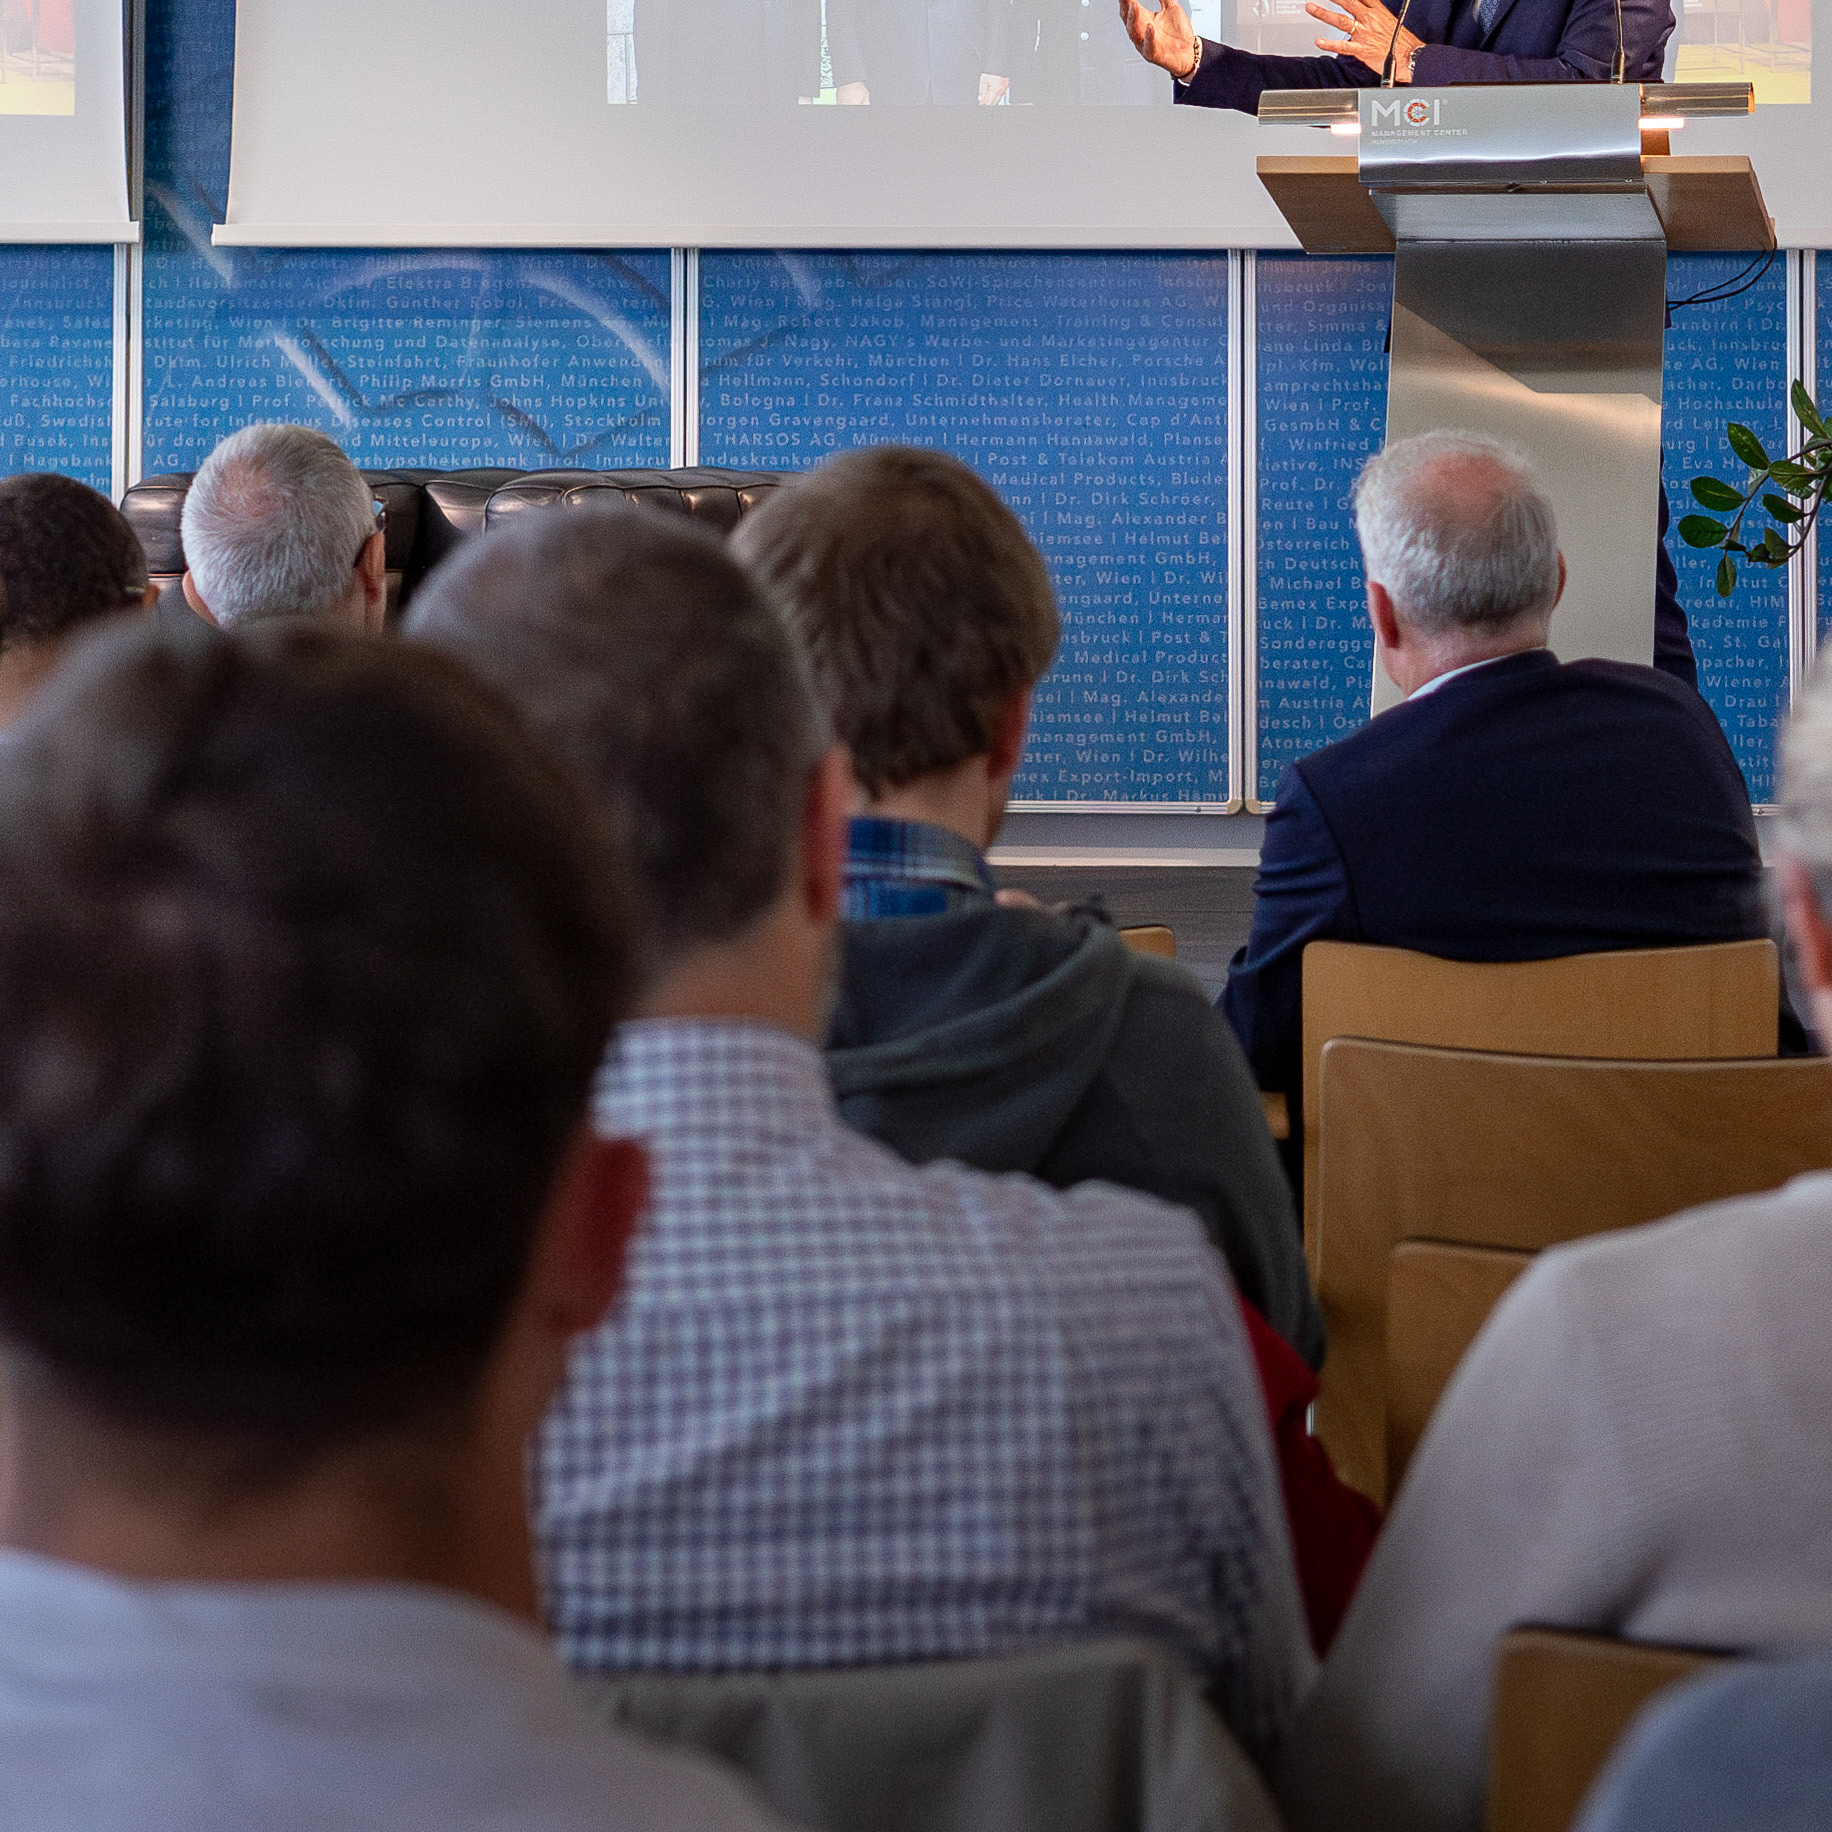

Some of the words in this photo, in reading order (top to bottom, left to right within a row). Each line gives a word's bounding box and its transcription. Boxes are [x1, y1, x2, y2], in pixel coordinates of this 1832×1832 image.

[1371, 98, 1440, 127] MCI
[1371, 129, 1432, 137] MANAGEMENT
[999, 335, 1032, 348] und
[868, 354, 950, 367] München
[1006, 354, 1050, 367] Hans
[820, 374, 914, 387] Schondorf
[971, 374, 1030, 387] Dieter
[720, 394, 796, 410] Bologna
[853, 394, 903, 407] Franz
[1058, 394, 1119, 407] Health
[1126, 414, 1161, 429] Cap
[715, 434, 801, 446] THARSOS
[852, 434, 935, 446] München
[955, 434, 1038, 446] Hermann
[987, 452, 1027, 465] Post
[1037, 452, 1048, 465] &
[1060, 452, 1135, 465] Telekom
[1144, 452, 1210, 465] Austria
[991, 474, 1065, 486] Medical
[1091, 492, 1128, 505] Dirk
[1111, 512, 1206, 525] Alexander
[1124, 532, 1189, 545] Helmut
[1096, 572, 1142, 584] Wien
